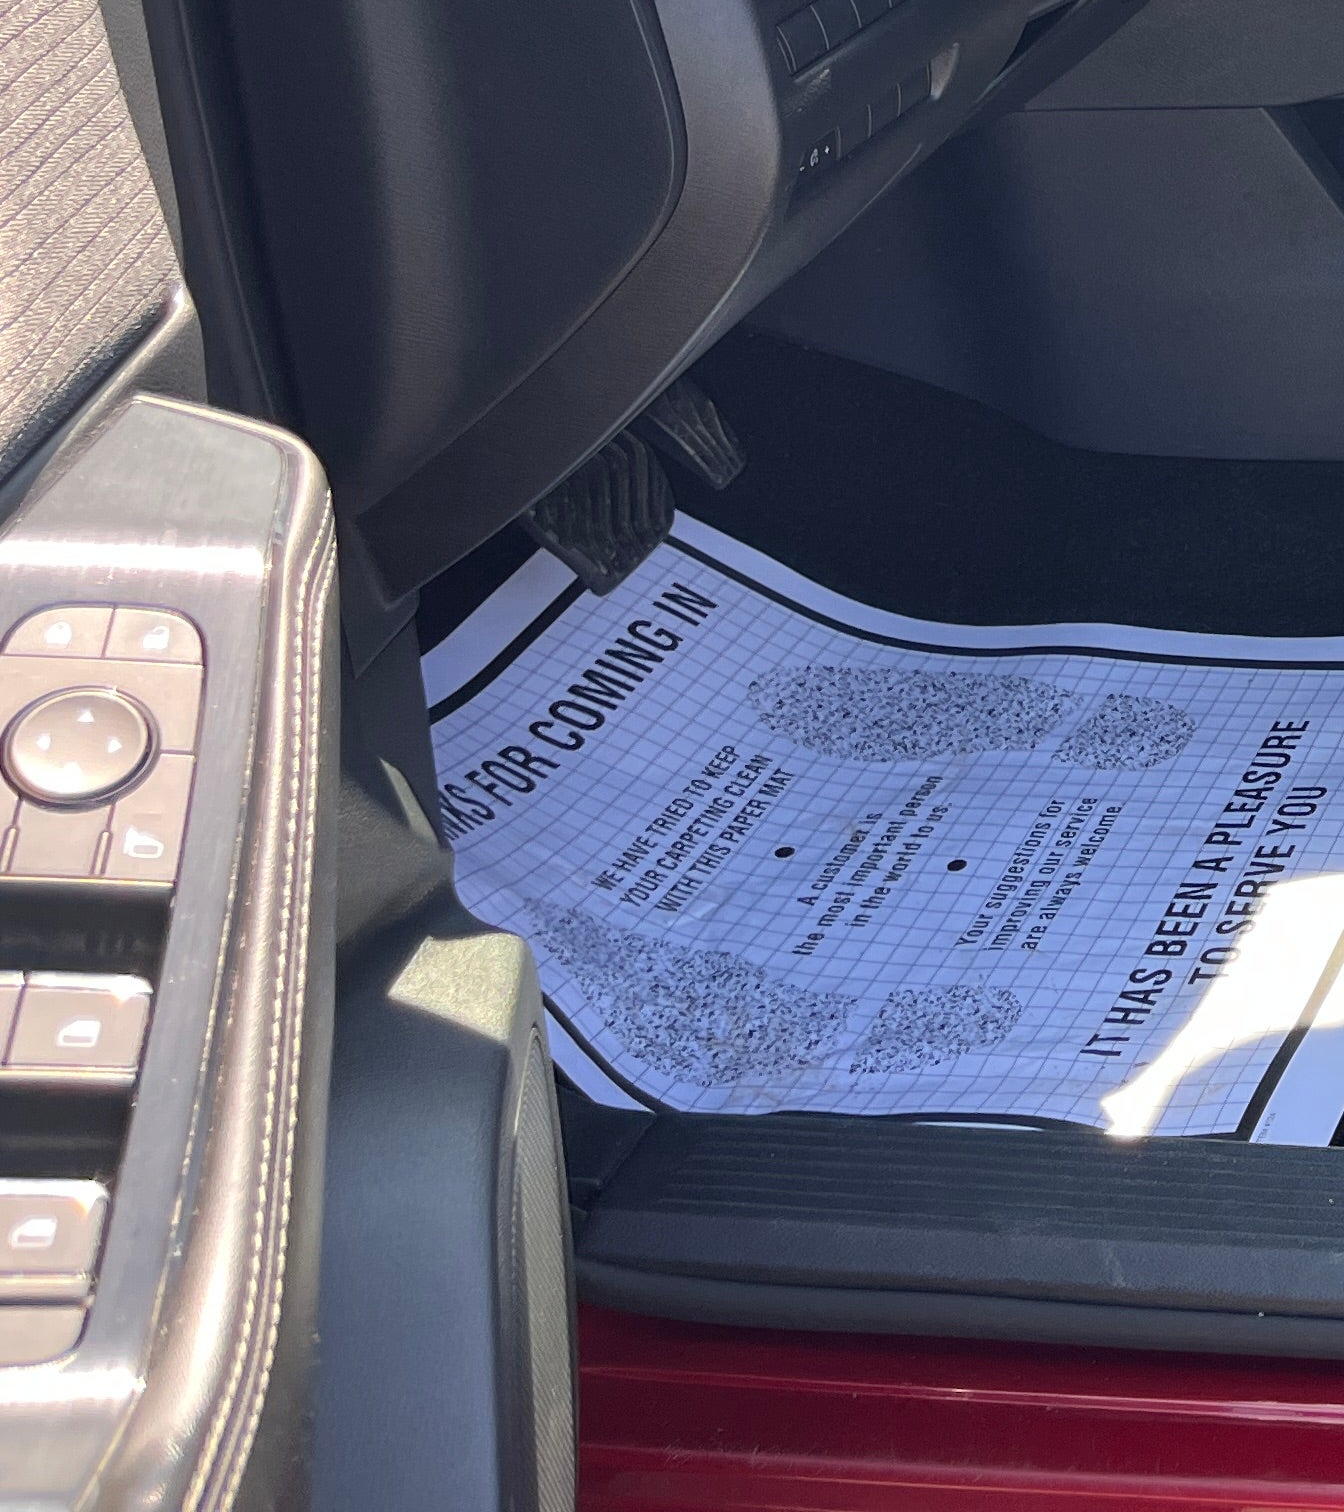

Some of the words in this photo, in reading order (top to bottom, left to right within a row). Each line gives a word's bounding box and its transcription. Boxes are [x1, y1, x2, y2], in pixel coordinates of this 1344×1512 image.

[464, 745, 560, 807] FOR
[528, 620, 684, 751] COMING
[652, 582, 719, 626] IN
[591, 870, 624, 891] WE
[612, 836, 658, 872] HAVE
[645, 798, 694, 836] TRIED
[682, 779, 712, 797] TO
[701, 745, 740, 778] KEEP
[620, 870, 668, 906] YOUR
[656, 797, 735, 870] CARPETING
[724, 754, 773, 797] CLEAN
[655, 874, 703, 912] WITH
[689, 844, 731, 874] THIS
[720, 799, 771, 843] PAPER
[758, 768, 795, 798] MAT
[1204, 720, 1310, 846] PLEASURE
[792, 932, 825, 955] the
[817, 891, 855, 927] most
[842, 821, 907, 887] important
[899, 775, 943, 817] person
[797, 896, 819, 906] A
[811, 829, 870, 891] customer
[858, 813, 883, 824] is
[844, 914, 872, 927] in
[860, 886, 891, 909] the
[882, 842, 922, 883] world
[909, 826, 935, 838] to
[954, 913, 993, 947] Your
[985, 822, 1051, 909] suggestions
[1039, 799, 1065, 818] for
[982, 880, 1051, 951] improving
[1039, 851, 1064, 875] our
[1056, 797, 1097, 848] service
[1020, 925, 1048, 951] are
[1039, 872, 1082, 920] always
[1073, 806, 1122, 867] welcome
[1145, 882, 1219, 957] BEEN
[1188, 946, 1241, 986] TO
[1216, 844, 1296, 935] SERVE
[1266, 786, 1328, 836] YOU
[1191, 856, 1234, 873] A
[1080, 1033, 1130, 1057] IT
[1103, 968, 1173, 1025] HAS
